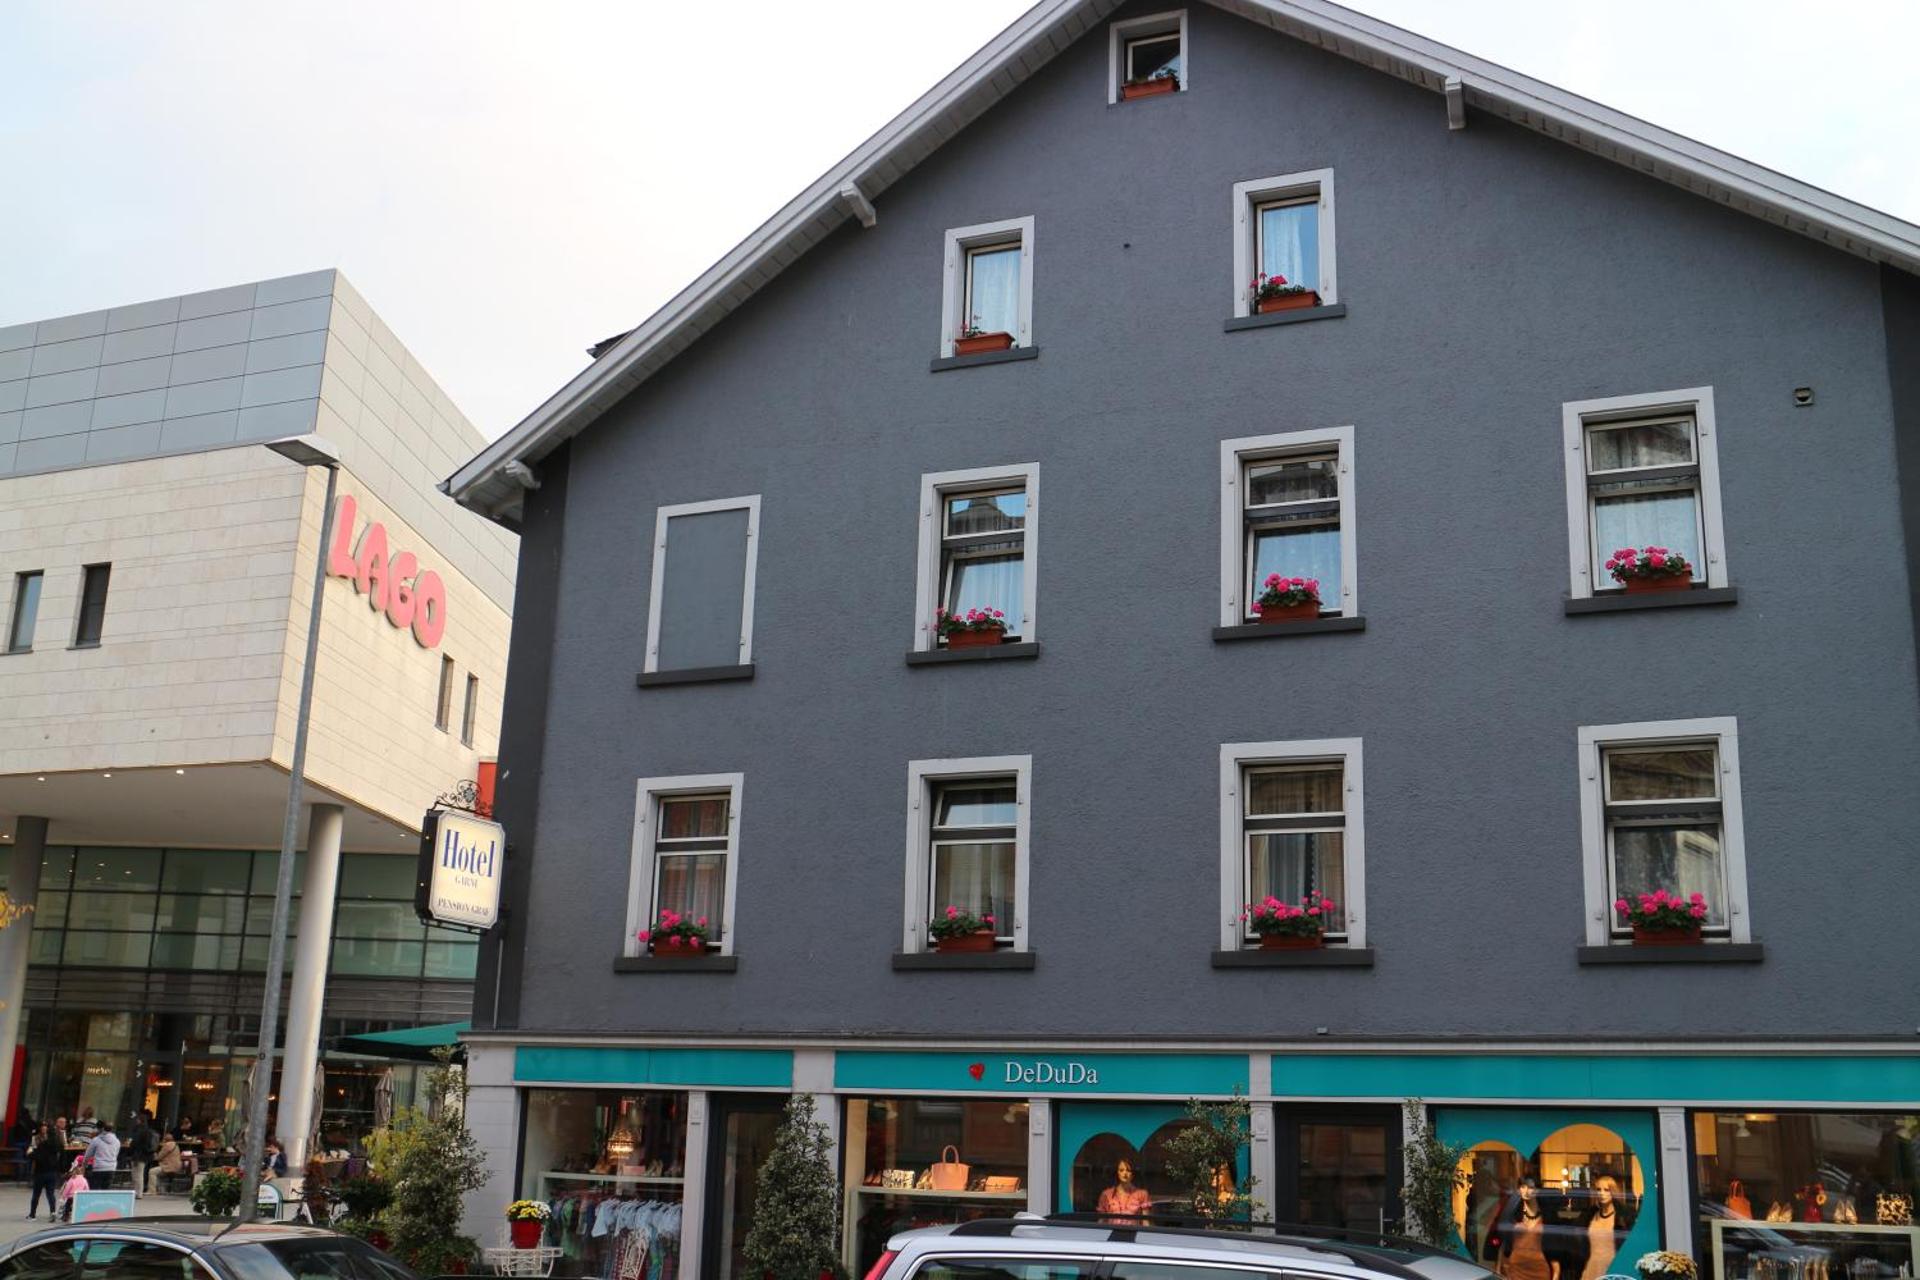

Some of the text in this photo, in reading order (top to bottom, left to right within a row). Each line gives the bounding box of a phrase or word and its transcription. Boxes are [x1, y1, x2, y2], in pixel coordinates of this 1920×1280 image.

[327, 494, 446, 649] LAGO
[442, 829, 495, 877] Hotel
[438, 898, 469, 912] PENSION
[1005, 1061, 1098, 1084] DeDuDa
